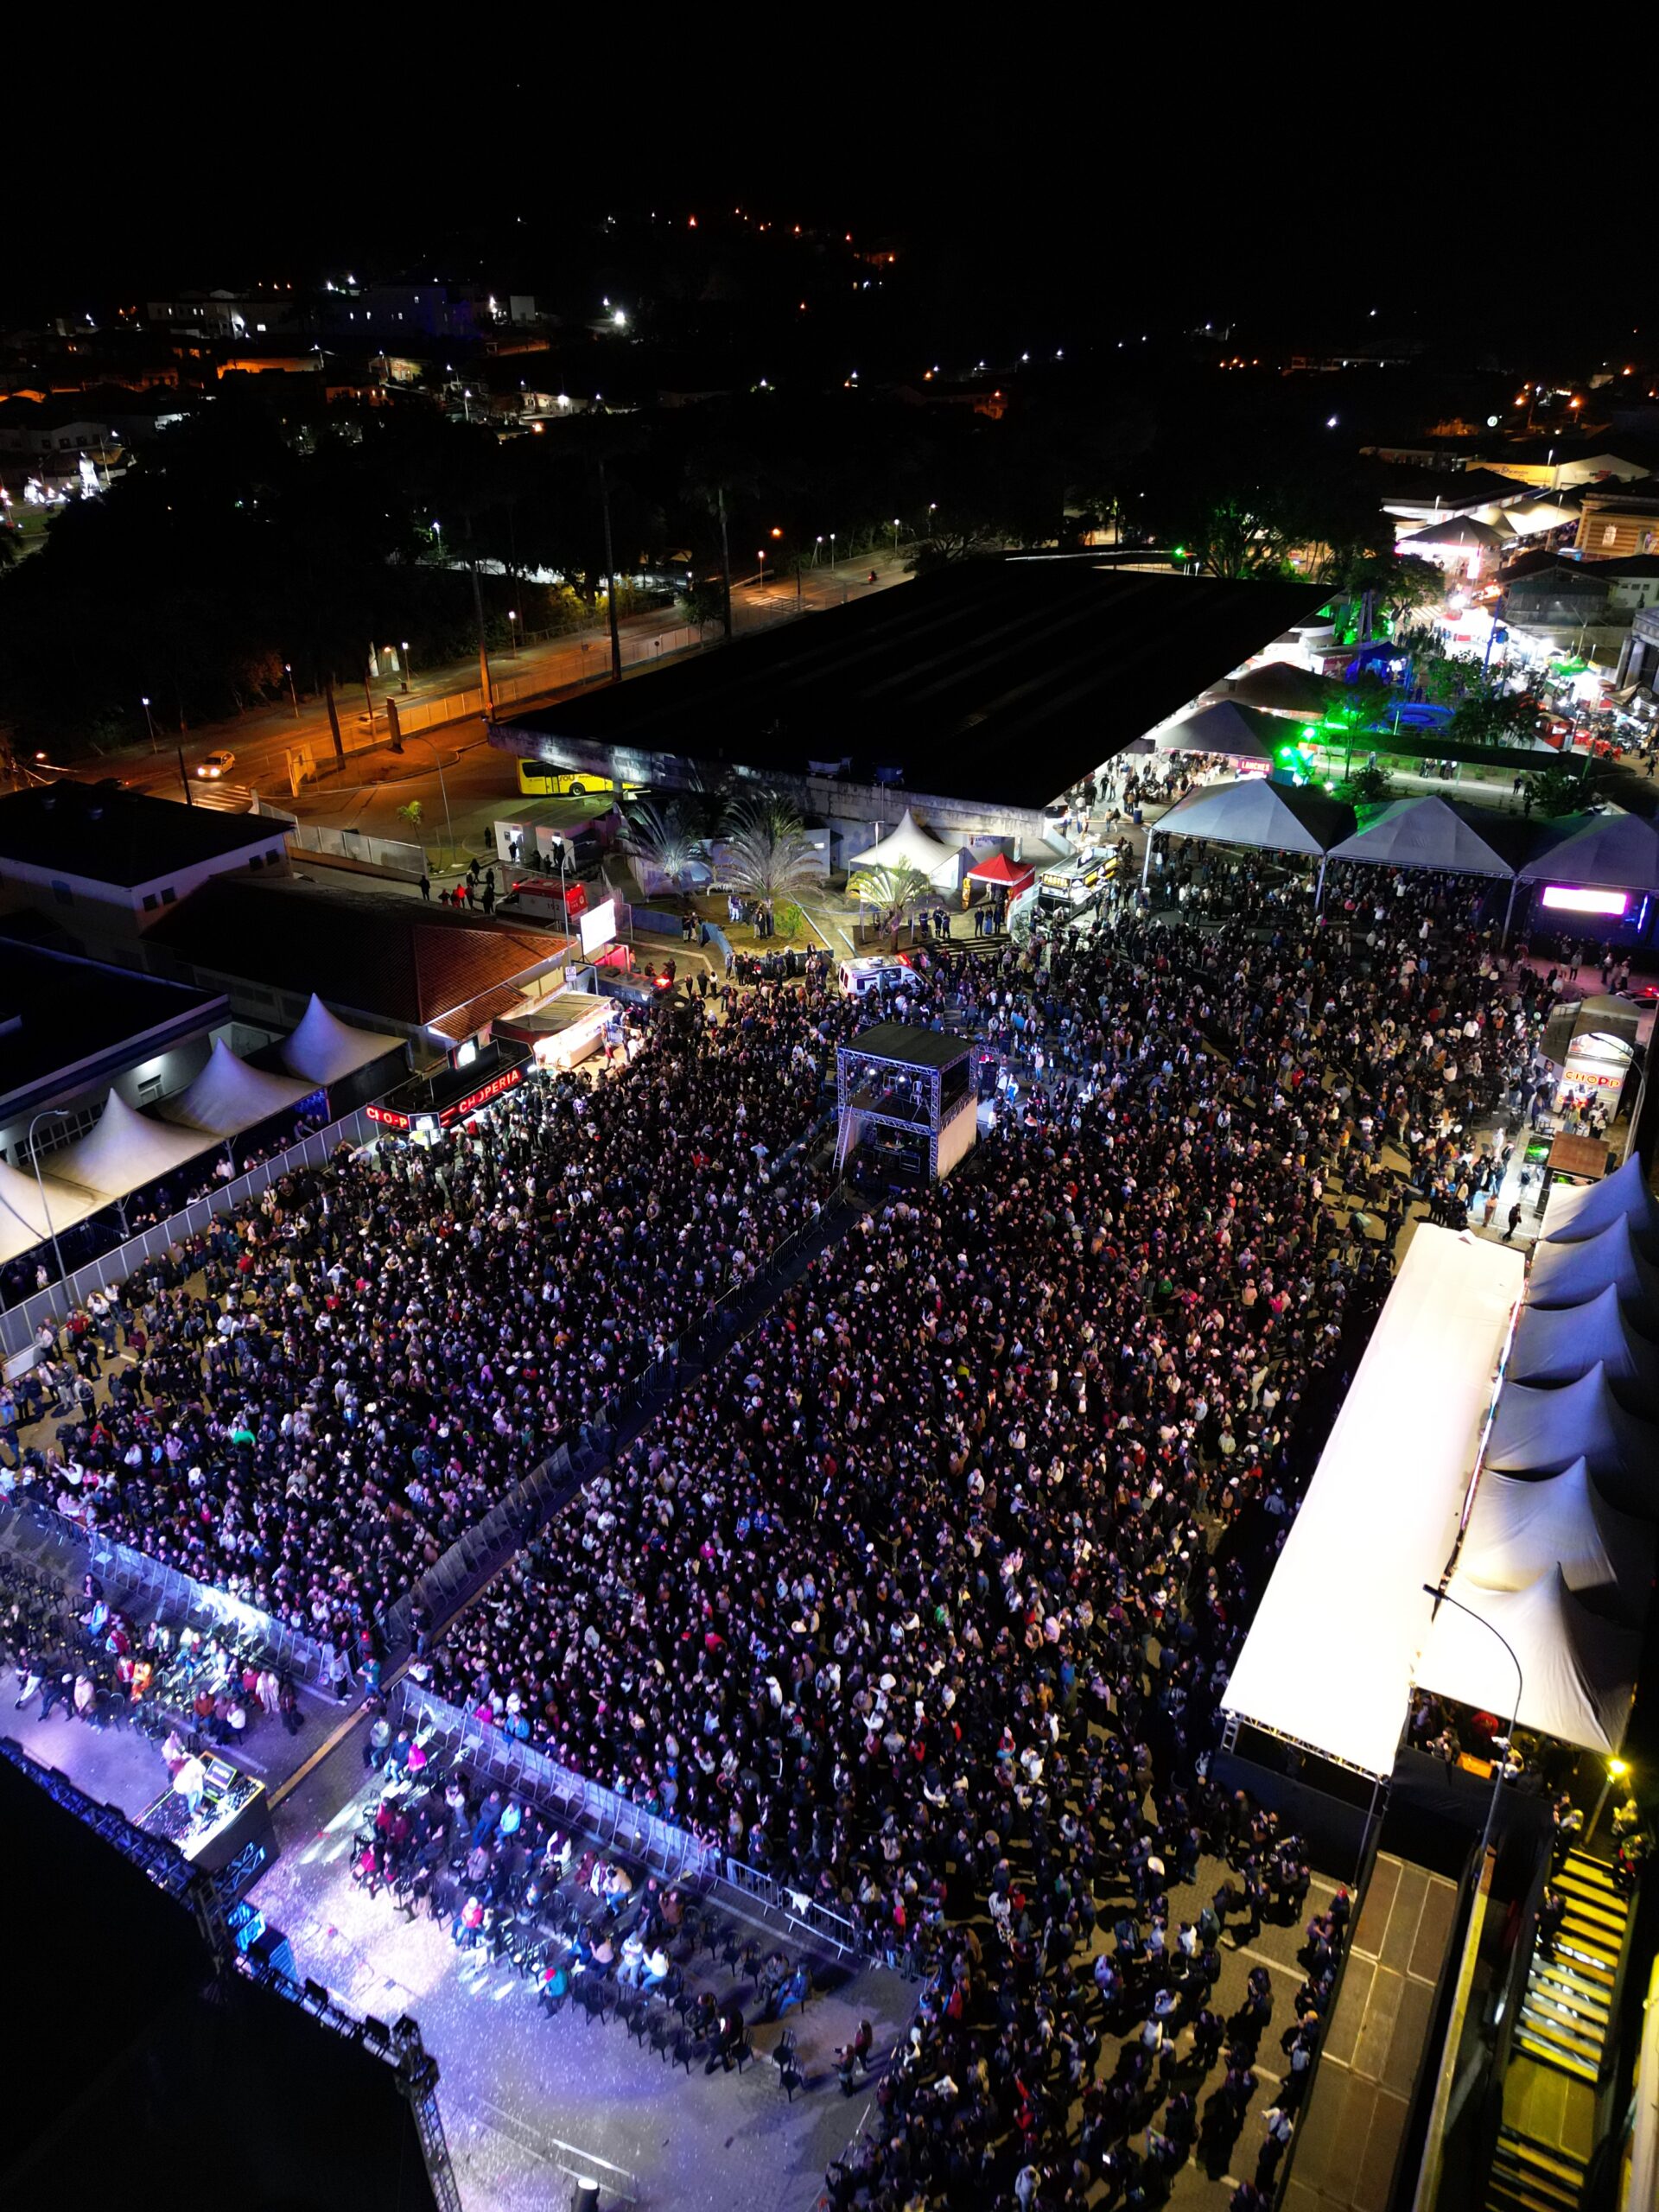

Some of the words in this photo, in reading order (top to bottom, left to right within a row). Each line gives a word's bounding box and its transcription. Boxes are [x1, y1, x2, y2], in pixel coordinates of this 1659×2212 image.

[1241, 760, 1270, 772] LANCHES
[1044, 874, 1069, 887] PASTEL
[1565, 1071, 1620, 1088] CHOPP
